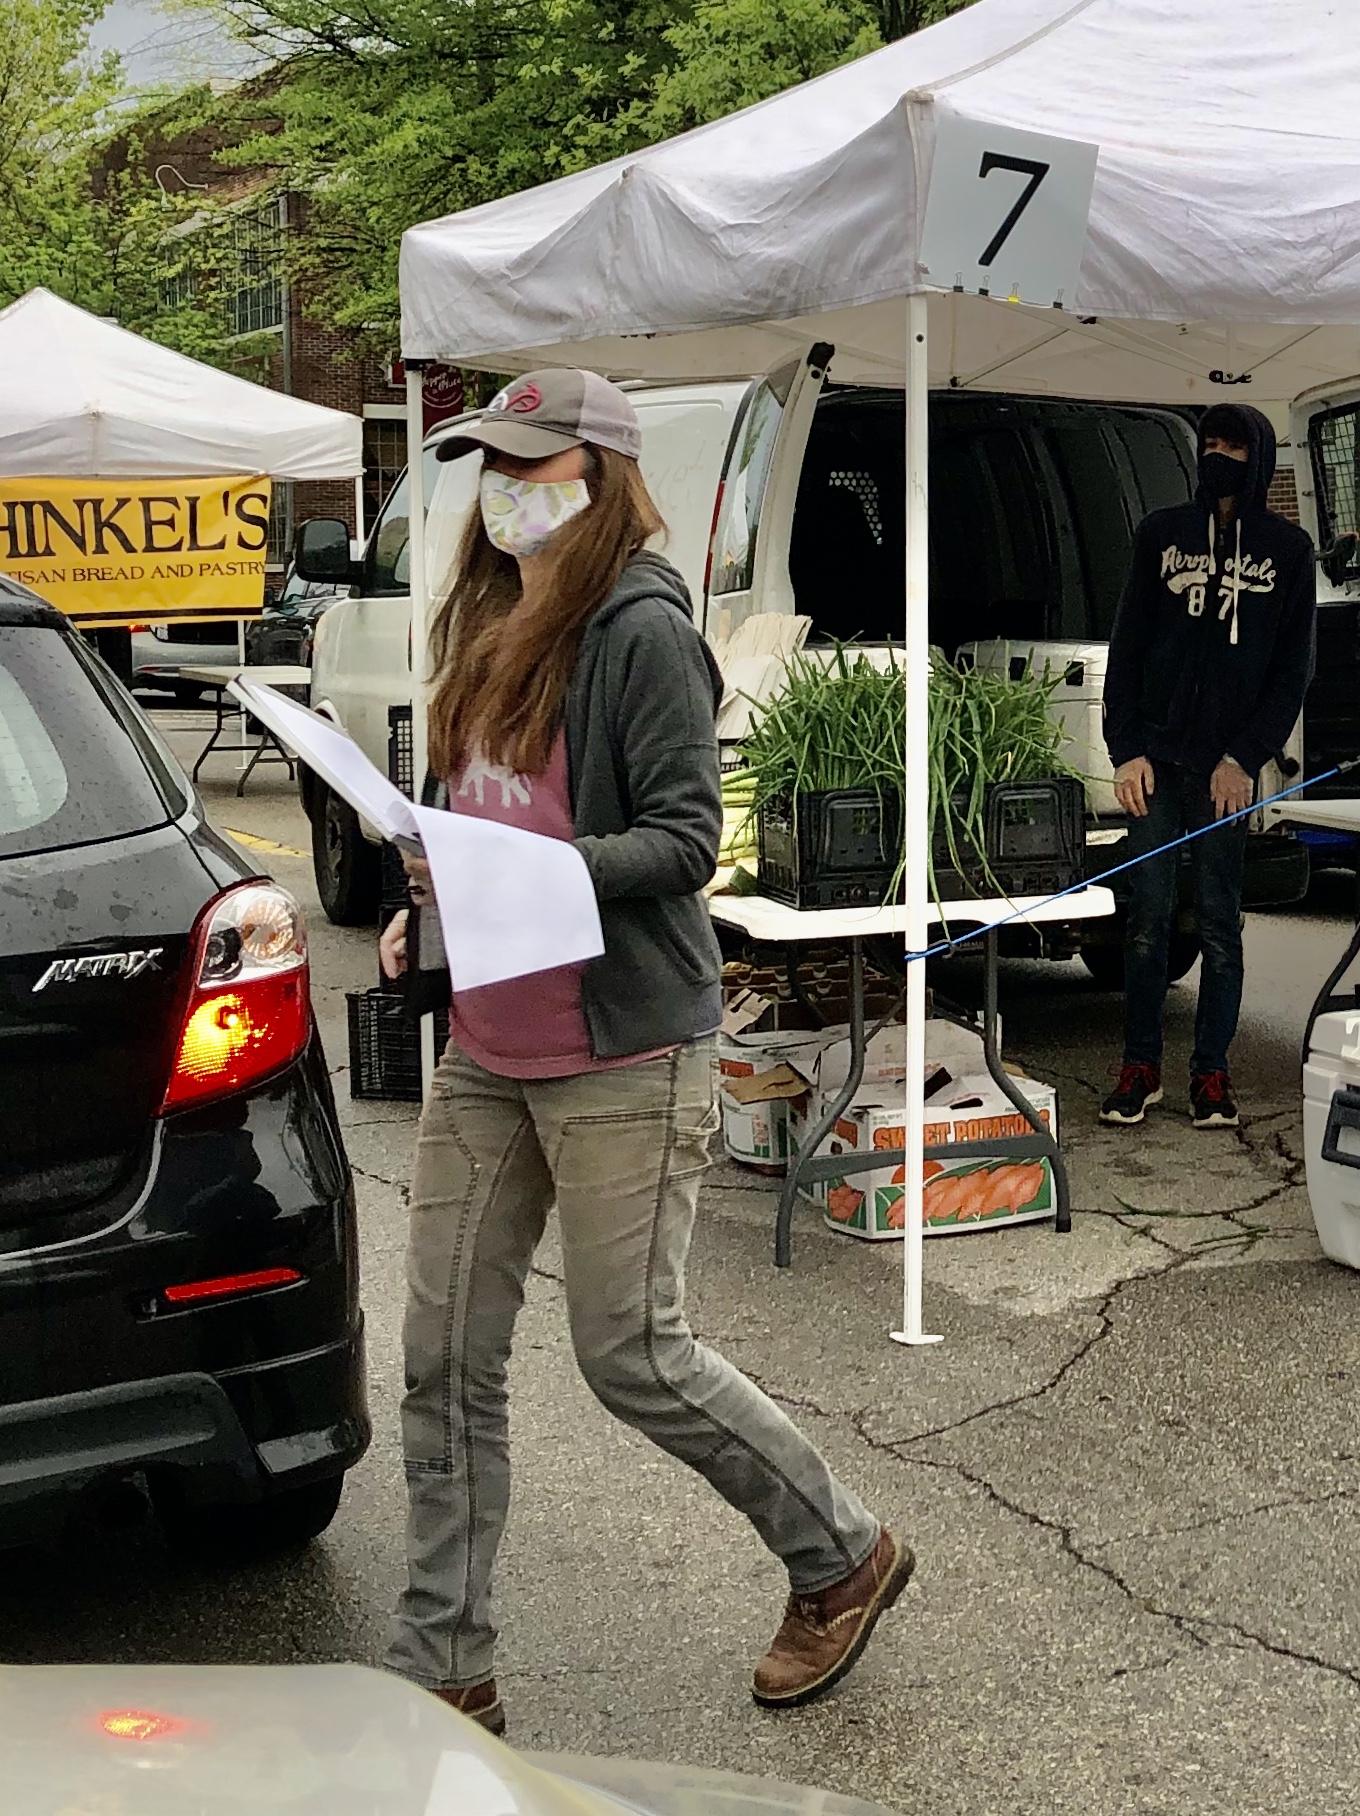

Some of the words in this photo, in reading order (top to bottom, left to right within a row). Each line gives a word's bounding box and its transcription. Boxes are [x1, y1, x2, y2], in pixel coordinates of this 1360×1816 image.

[977, 150, 1051, 267] 7
[72, 566, 145, 582] BREAD
[150, 563, 194, 580] AND
[198, 560, 267, 577] PASTRY
[32, 948, 164, 993] MATRIX
[873, 1121, 951, 1151] SWET
